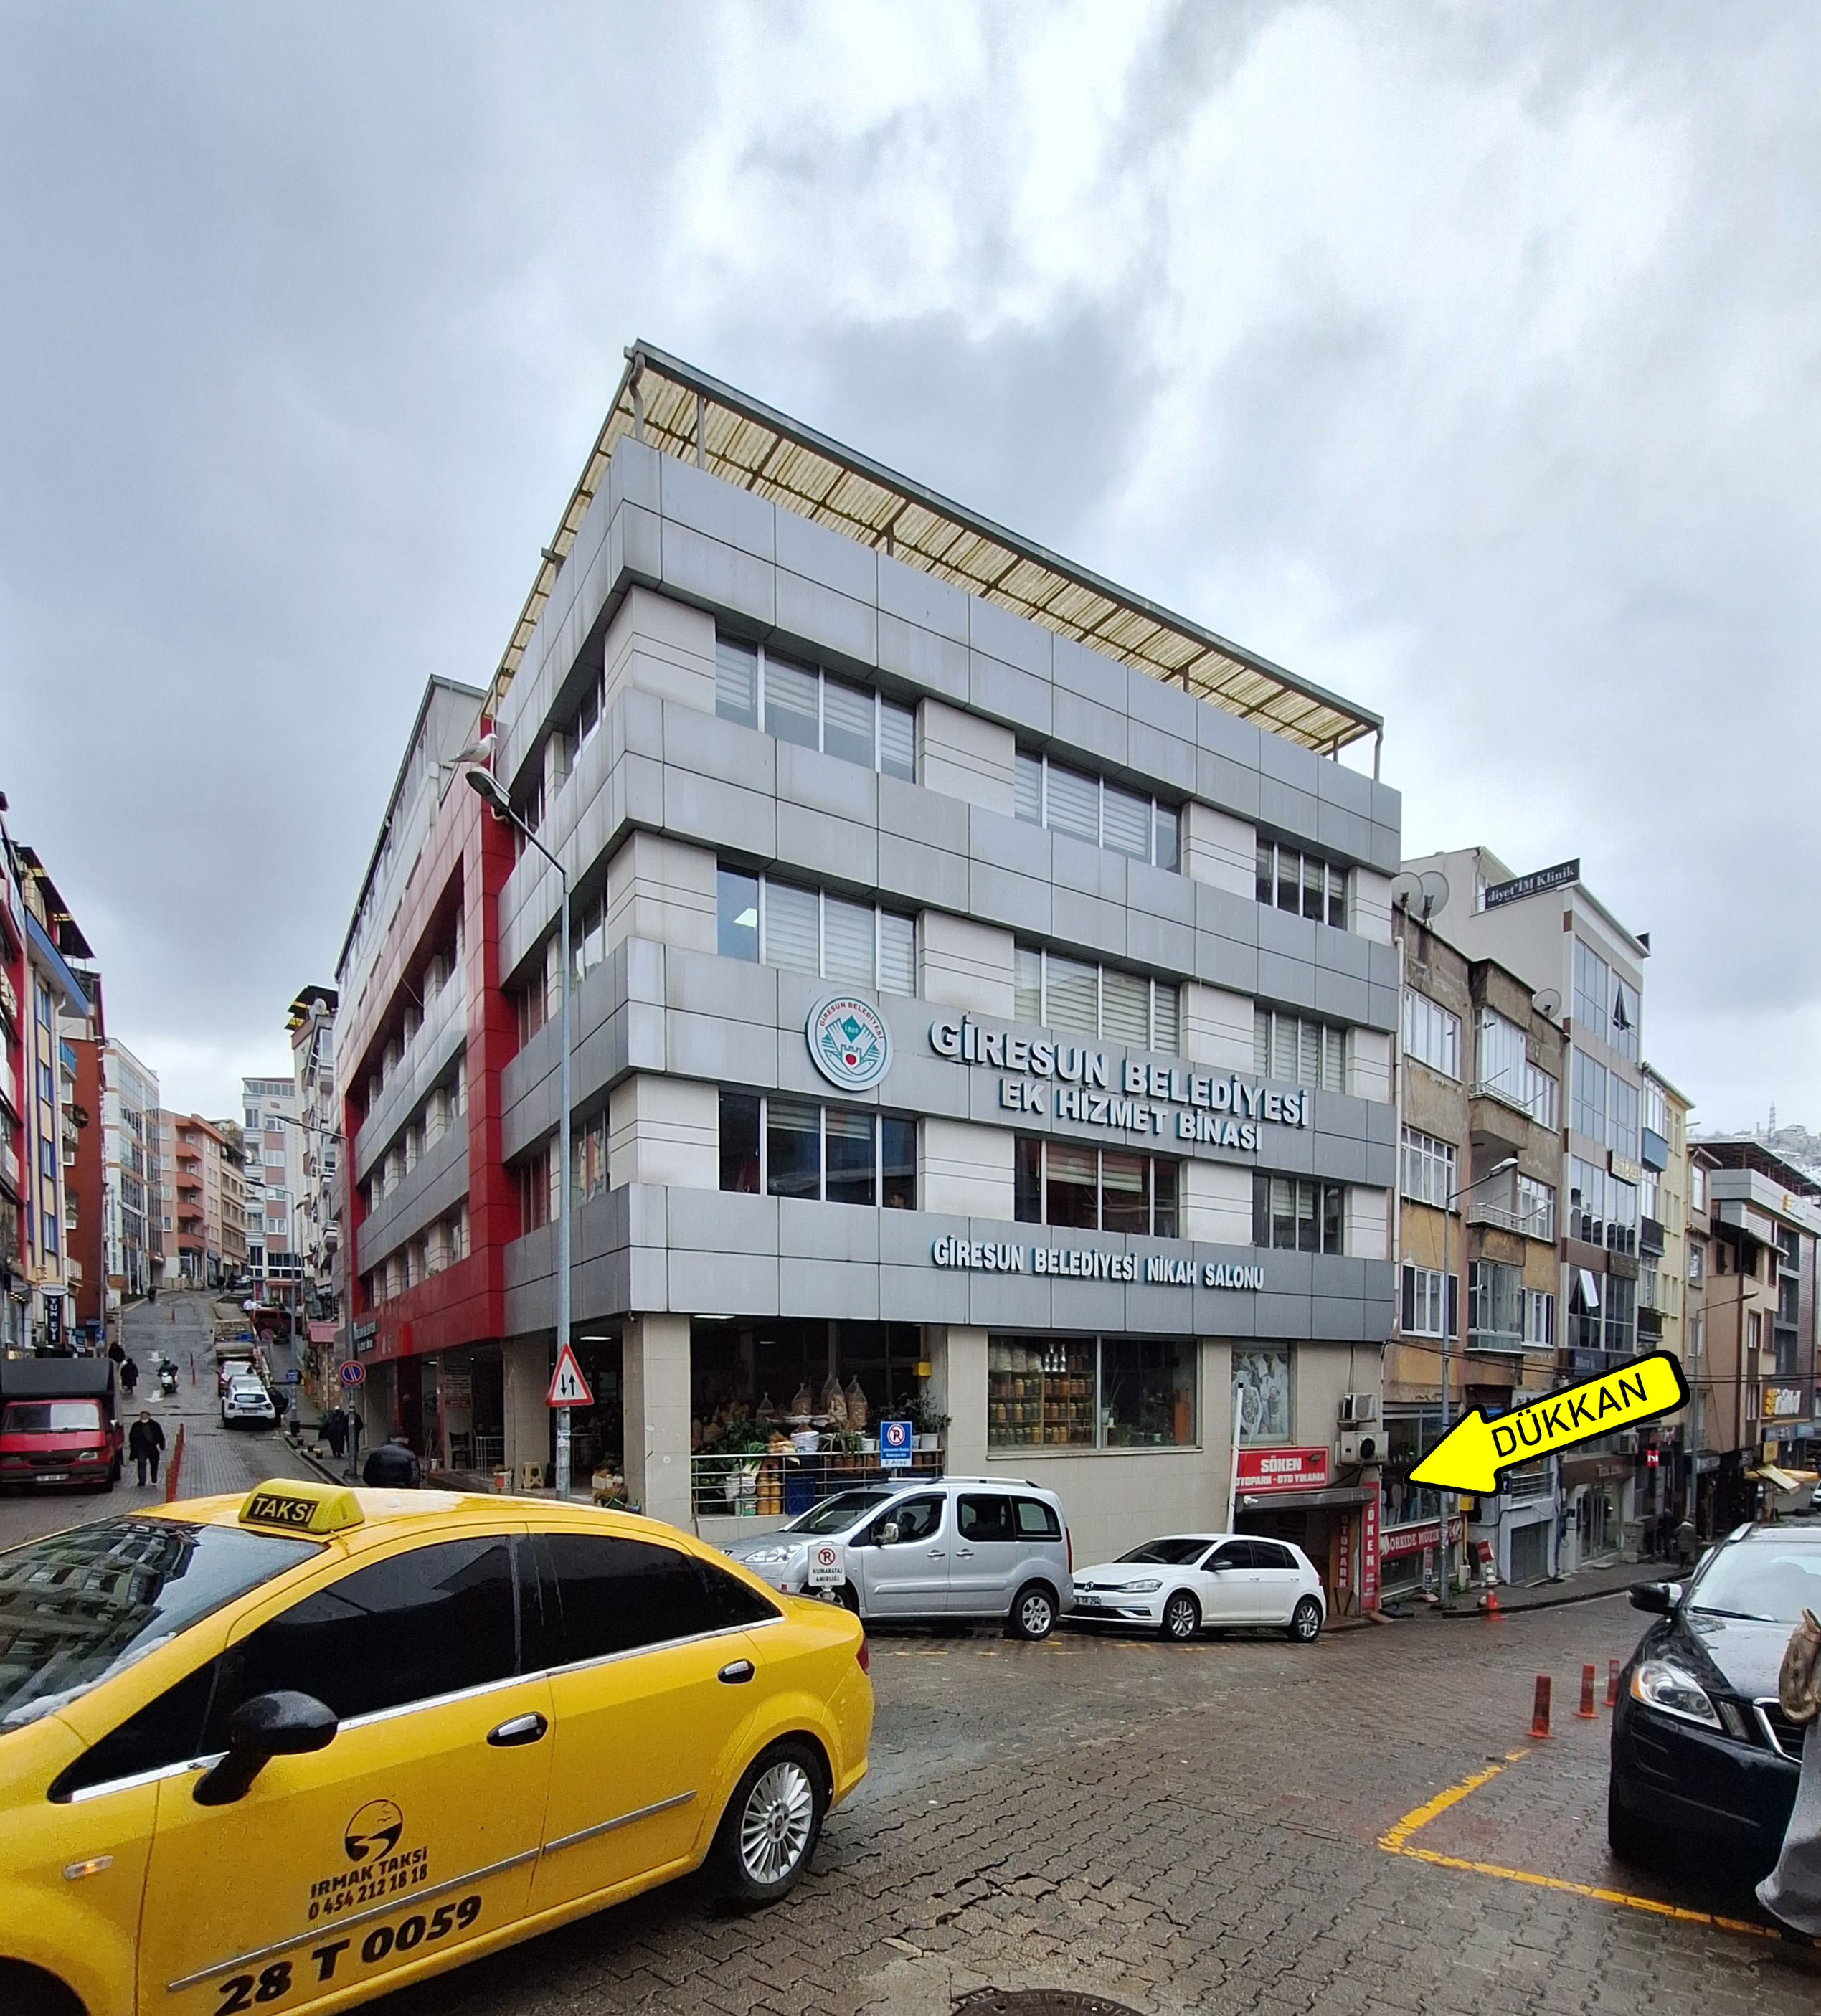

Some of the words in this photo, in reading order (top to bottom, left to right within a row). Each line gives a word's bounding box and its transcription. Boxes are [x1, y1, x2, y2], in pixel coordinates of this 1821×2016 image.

[1536, 866, 1575, 887] Klinik
[930, 1014, 1110, 1088] GİRESUN
[1124, 1059, 1310, 1126] BELEDİYESİ
[1000, 1078, 1045, 1114] EK
[1057, 1088, 1168, 1135] HİZMET
[1178, 1109, 1262, 1151] BİNASI
[933, 1235, 1024, 1271] GİRESUN
[1032, 1246, 1139, 1281] BELEDİYESİ
[1145, 1254, 1198, 1284] NİKAH
[1204, 1263, 1264, 1289] SALONU
[1261, 1455, 1302, 1473] SÖKEN
[1277, 1474, 1293, 1484] OTO
[1366, 1500, 1375, 1566] ÖKEN
[308, 1901, 320, 1921] 0
[323, 1889, 354, 1915] 454
[356, 1878, 386, 1904] 212
[389, 1870, 407, 1893] 18
[410, 1863, 428, 1885] 18
[310, 1864, 374, 1899] IRMAK
[214, 1960, 293, 2016] 28
[311, 1938, 351, 1982] T
[361, 1895, 482, 1964] 0059
